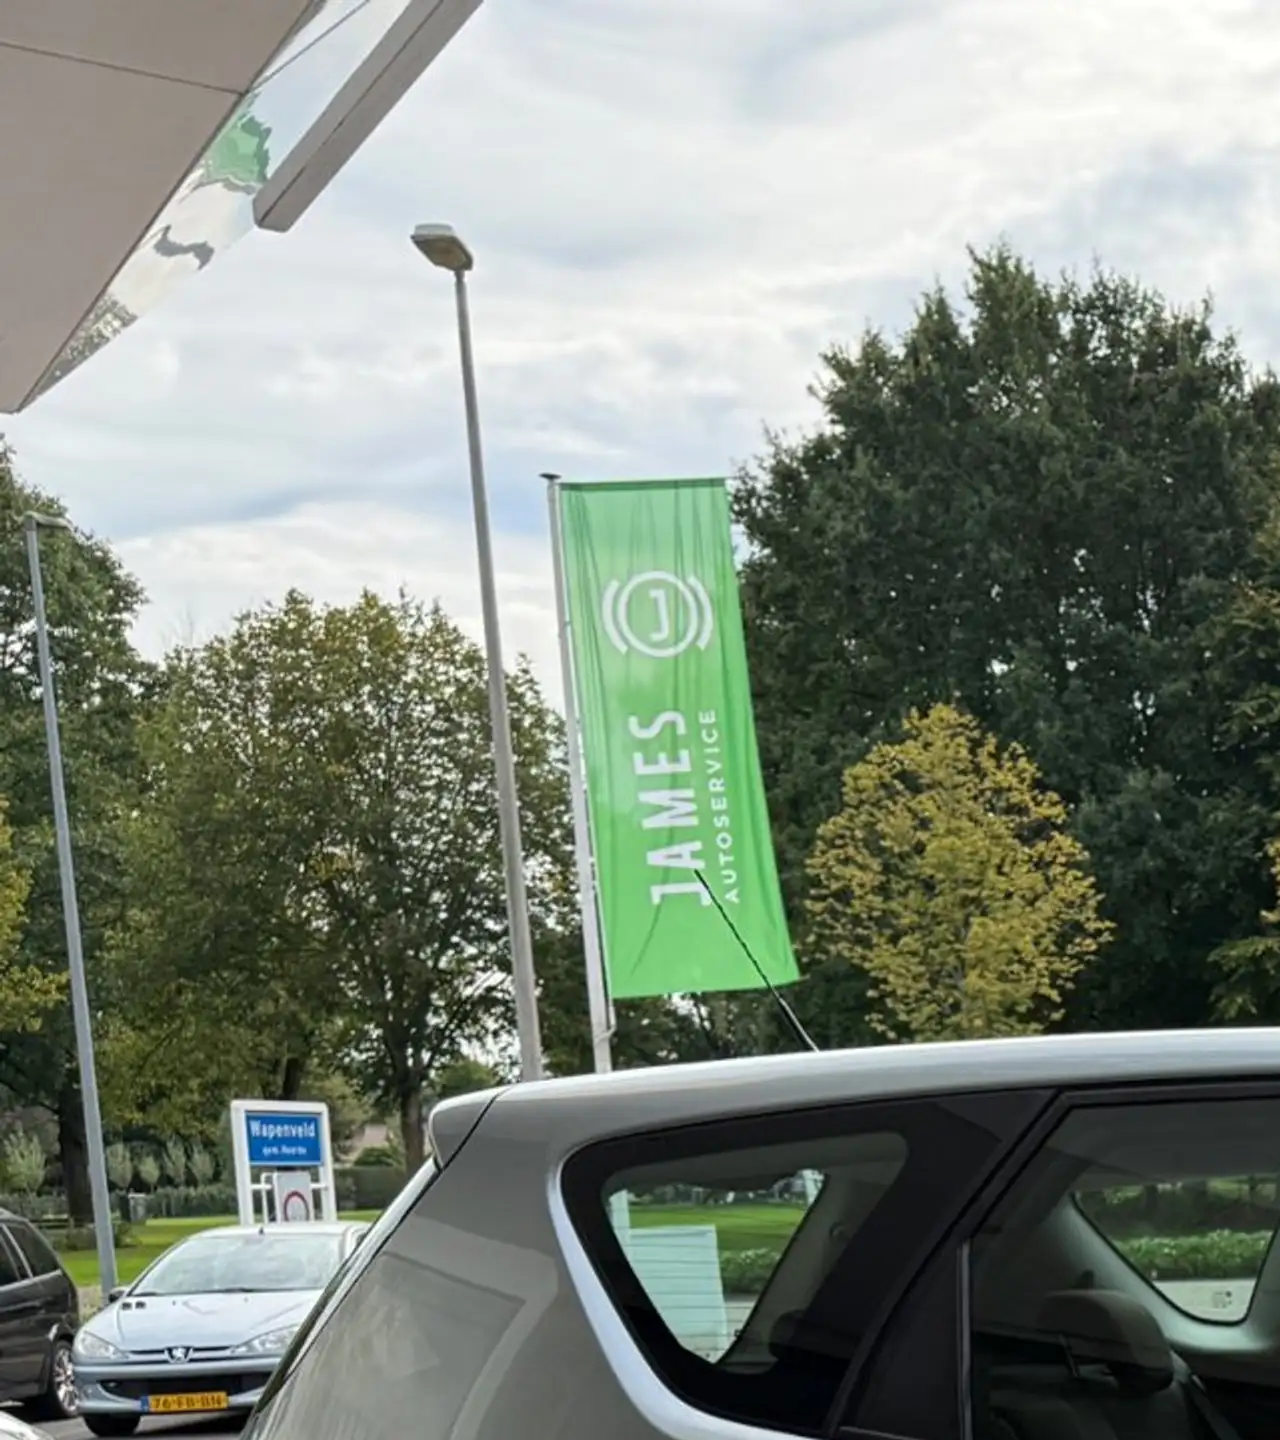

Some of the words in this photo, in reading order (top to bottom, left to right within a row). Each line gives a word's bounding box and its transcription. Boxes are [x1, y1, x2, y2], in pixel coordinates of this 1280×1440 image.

[628, 711, 712, 907] JAMES
[698, 709, 741, 904] AUTOSERVICE
[249, 1119, 316, 1140] Wapenveld
